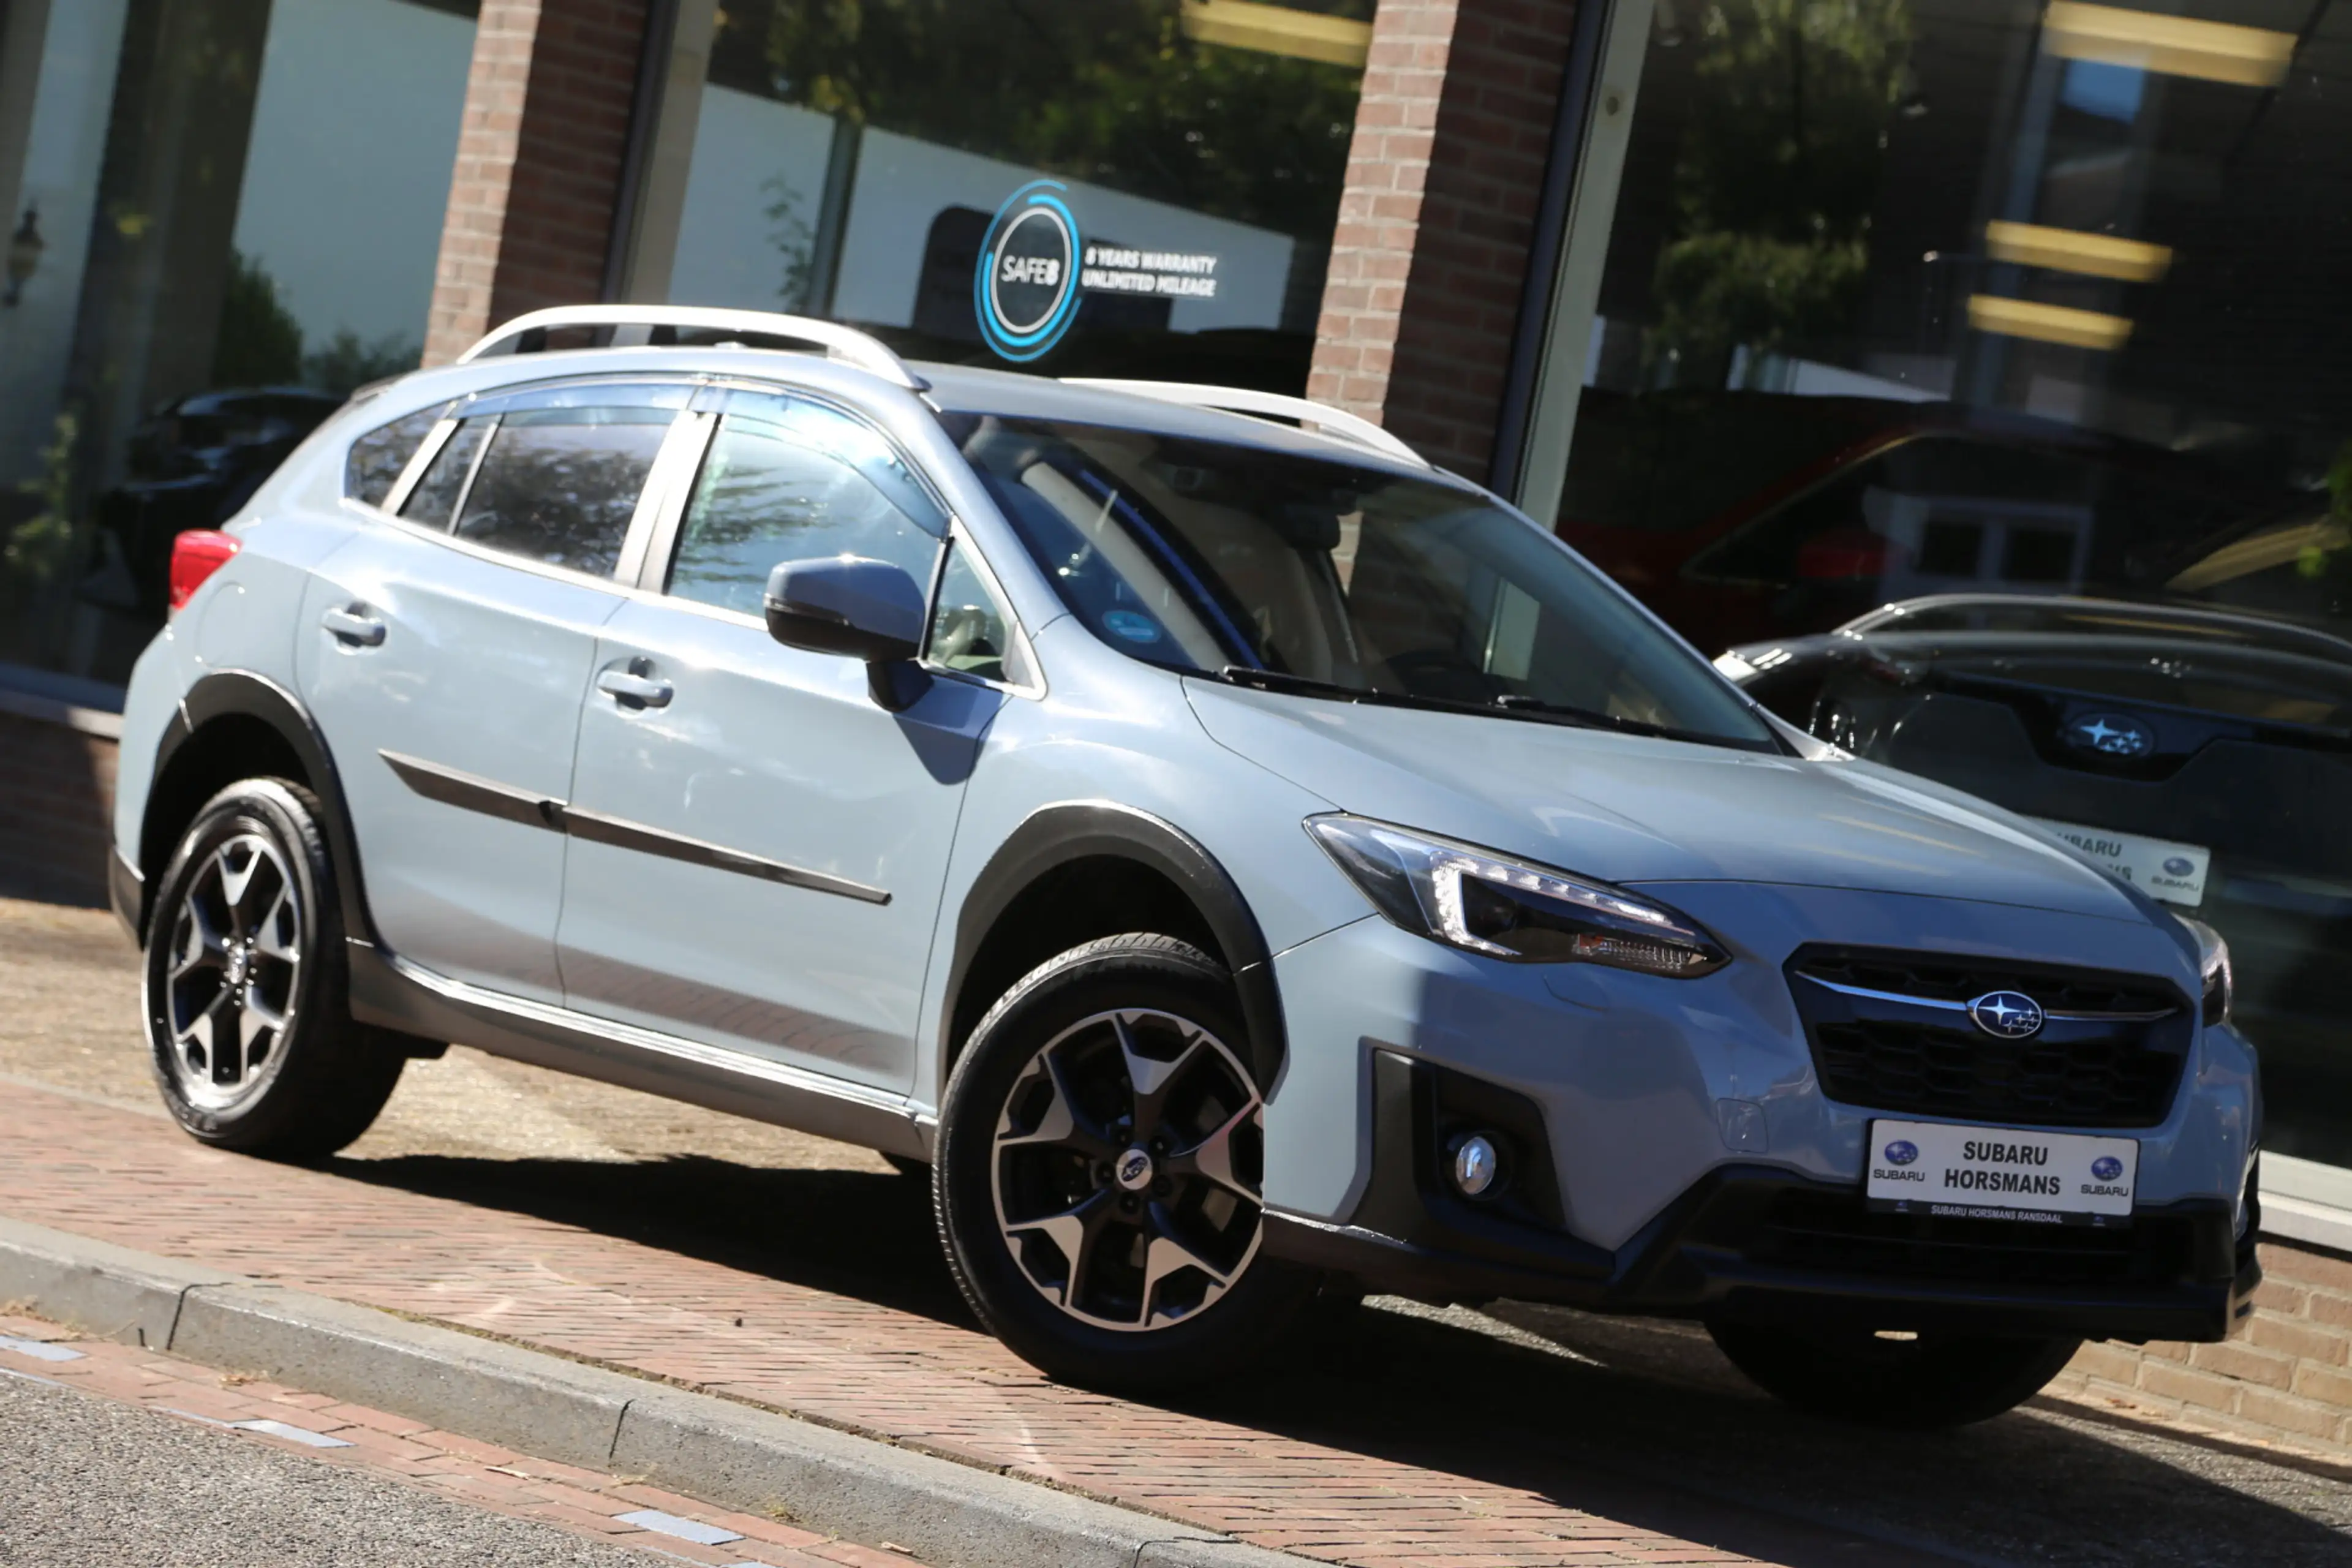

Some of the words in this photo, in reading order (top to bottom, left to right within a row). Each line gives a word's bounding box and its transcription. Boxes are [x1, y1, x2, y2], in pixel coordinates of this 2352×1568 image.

[1001, 255, 1060, 286] SAFE8
[1085, 247, 1096, 266] 8
[1098, 248, 1140, 269] YEARS
[1141, 251, 1217, 274] WARRANTY
[1081, 270, 1155, 292] UNLIMITED
[1156, 275, 1216, 296] MILEAGE
[2151, 875, 2199, 891] SUBARU
[1963, 1140, 2048, 1166] SUBARU
[1874, 1169, 1926, 1182] SUBARU
[1944, 1169, 2061, 1196] HORSMANS
[2081, 1184, 2129, 1197] SUBARU
[1931, 1204, 1967, 1217] SUBARU
[1969, 1207, 2016, 1221] HORSMANS
[2018, 1211, 2063, 1224] RANSDAAL
